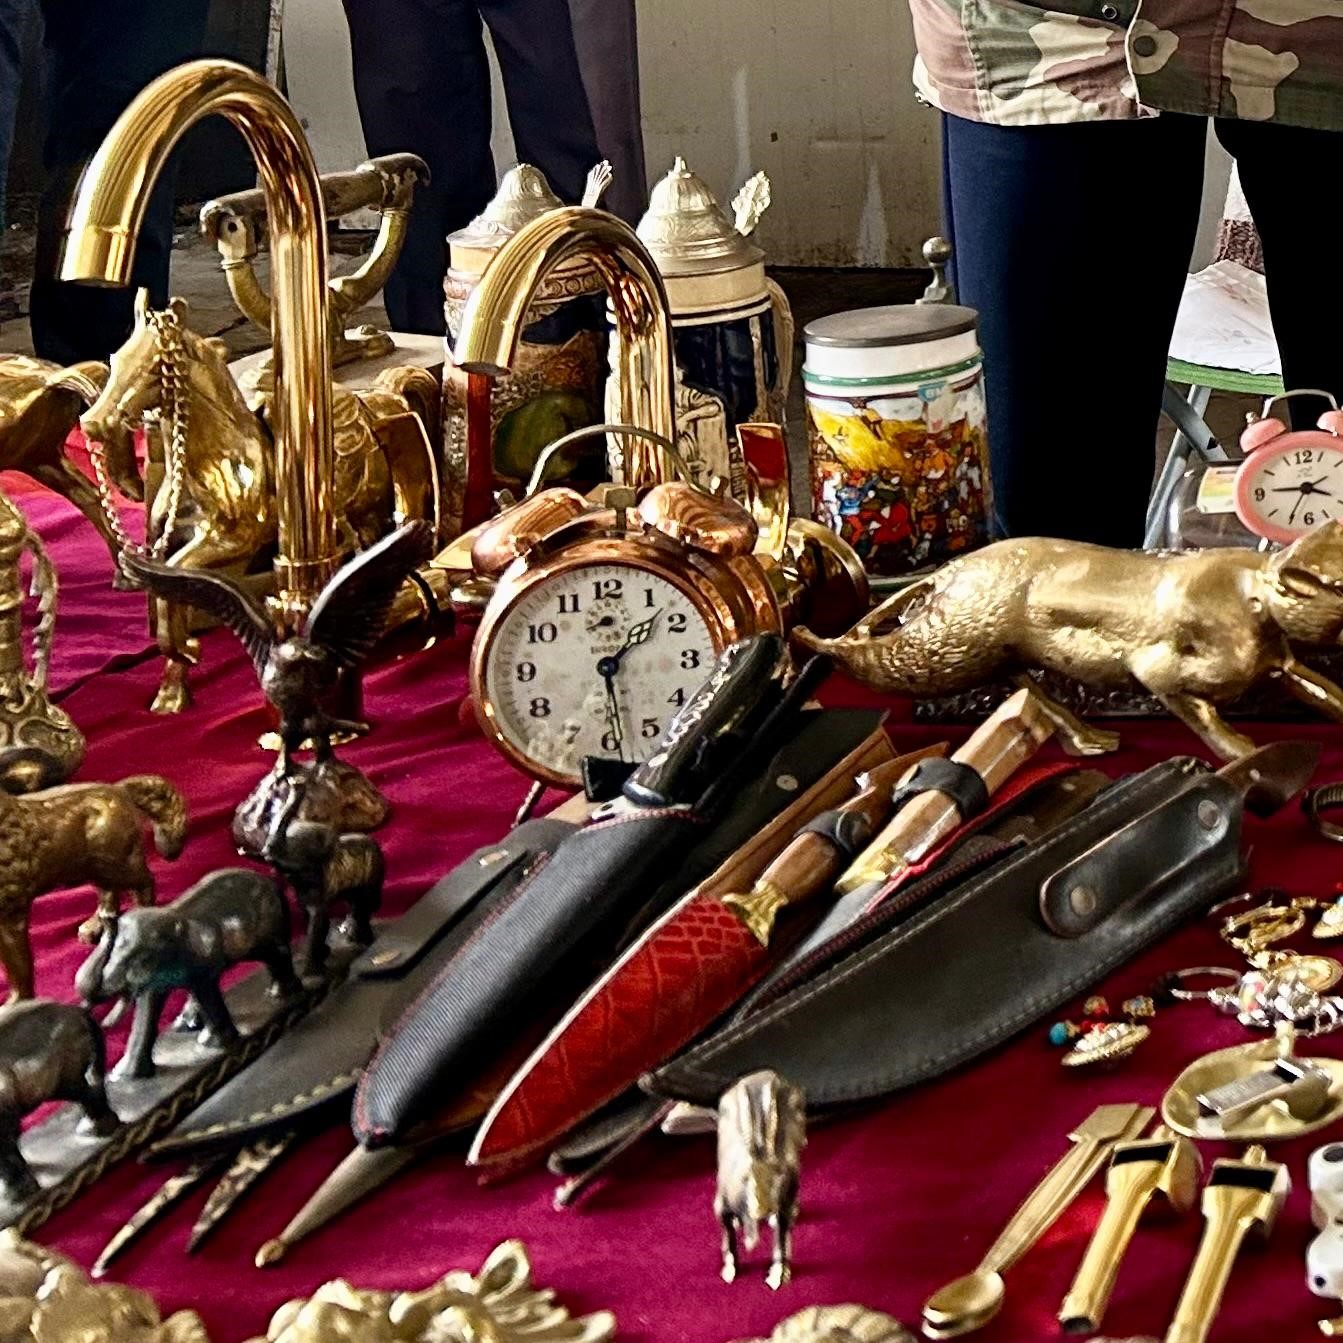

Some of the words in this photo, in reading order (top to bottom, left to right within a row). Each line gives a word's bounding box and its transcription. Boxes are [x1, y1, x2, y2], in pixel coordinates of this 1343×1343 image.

[1294, 449, 1313, 465] 12
[1254, 487, 1266, 502] 9
[1303, 511, 1314, 526] 6
[591, 578, 623, 601] 12
[643, 588, 655, 607] 1
[556, 593, 581, 614] 11
[527, 622, 558, 644] 10
[667, 613, 687, 634] 2
[680, 648, 700, 670] 3
[516, 661, 537, 683] 9
[529, 697, 551, 718] 8
[667, 687, 684, 707] 4
[641, 717, 661, 738] 5
[601, 731, 621, 752] 6
